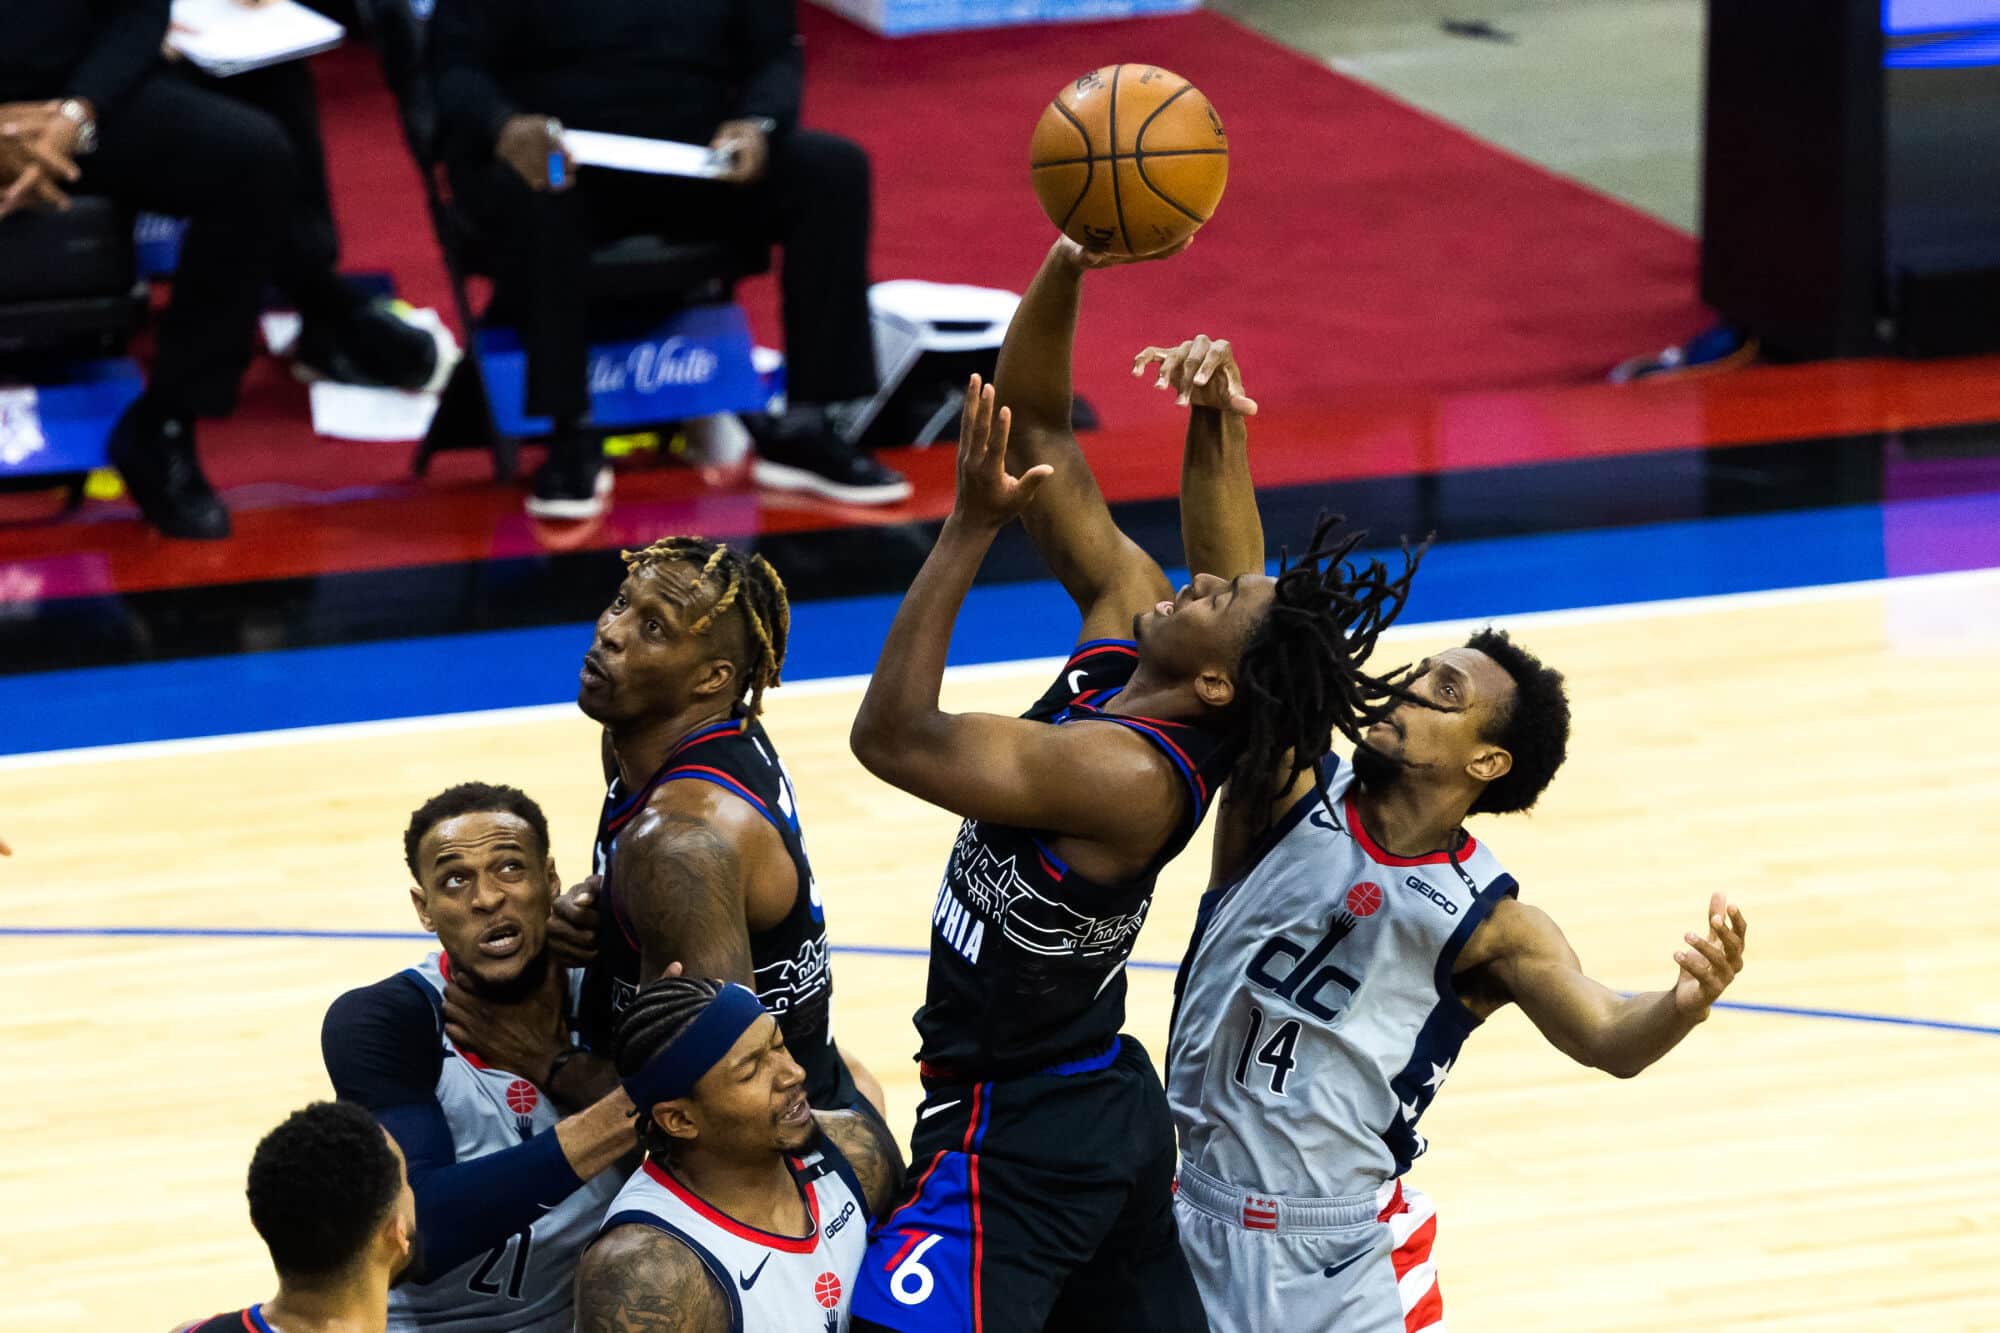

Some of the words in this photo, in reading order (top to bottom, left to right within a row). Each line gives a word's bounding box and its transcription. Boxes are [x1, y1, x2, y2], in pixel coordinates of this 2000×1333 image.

[1405, 875, 1458, 916] GEICO
[1233, 1006, 1302, 1097] 14
[825, 1201, 856, 1240] GEICO
[466, 1223, 536, 1301] 21
[883, 1228, 945, 1305] 76
